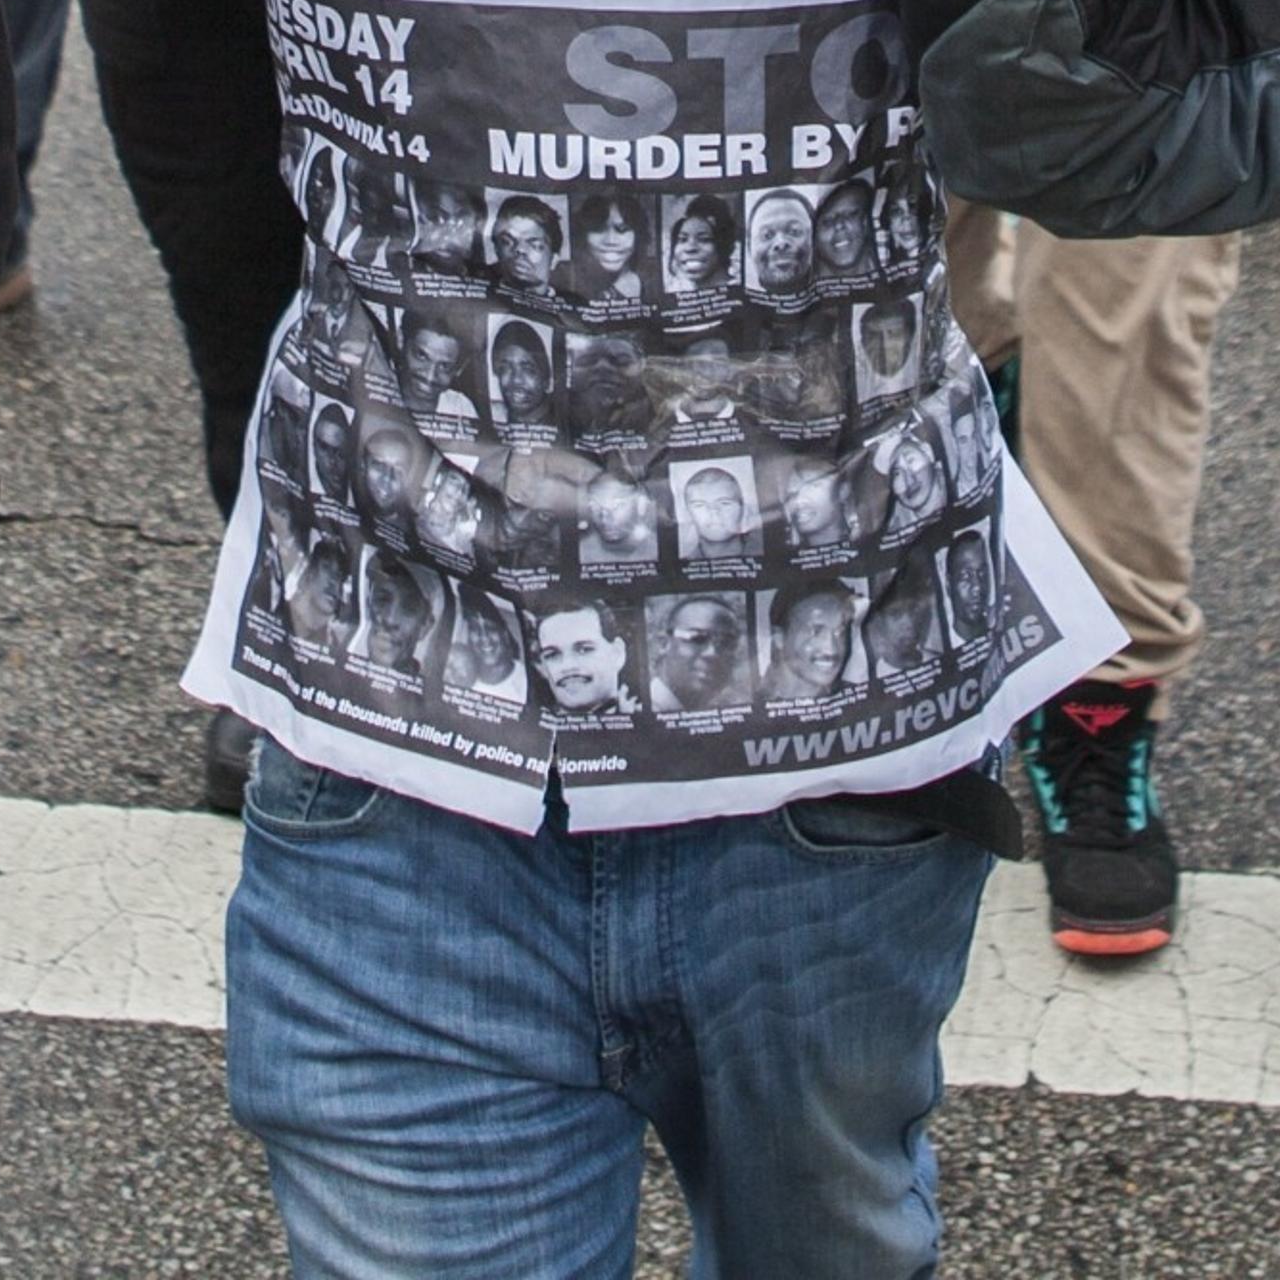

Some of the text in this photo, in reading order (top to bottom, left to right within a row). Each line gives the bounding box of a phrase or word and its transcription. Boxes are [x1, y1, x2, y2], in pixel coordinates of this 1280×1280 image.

[354, 64, 413, 115] 14
[487, 128, 767, 180] MURDER
[791, 122, 868, 169] BY
[243, 645, 272, 672] These
[301, 686, 316, 703] of
[315, 689, 337, 711] the
[338, 698, 407, 735] thousands
[410, 720, 453, 747] killed
[453, 734, 474, 756] by
[475, 742, 522, 768] police
